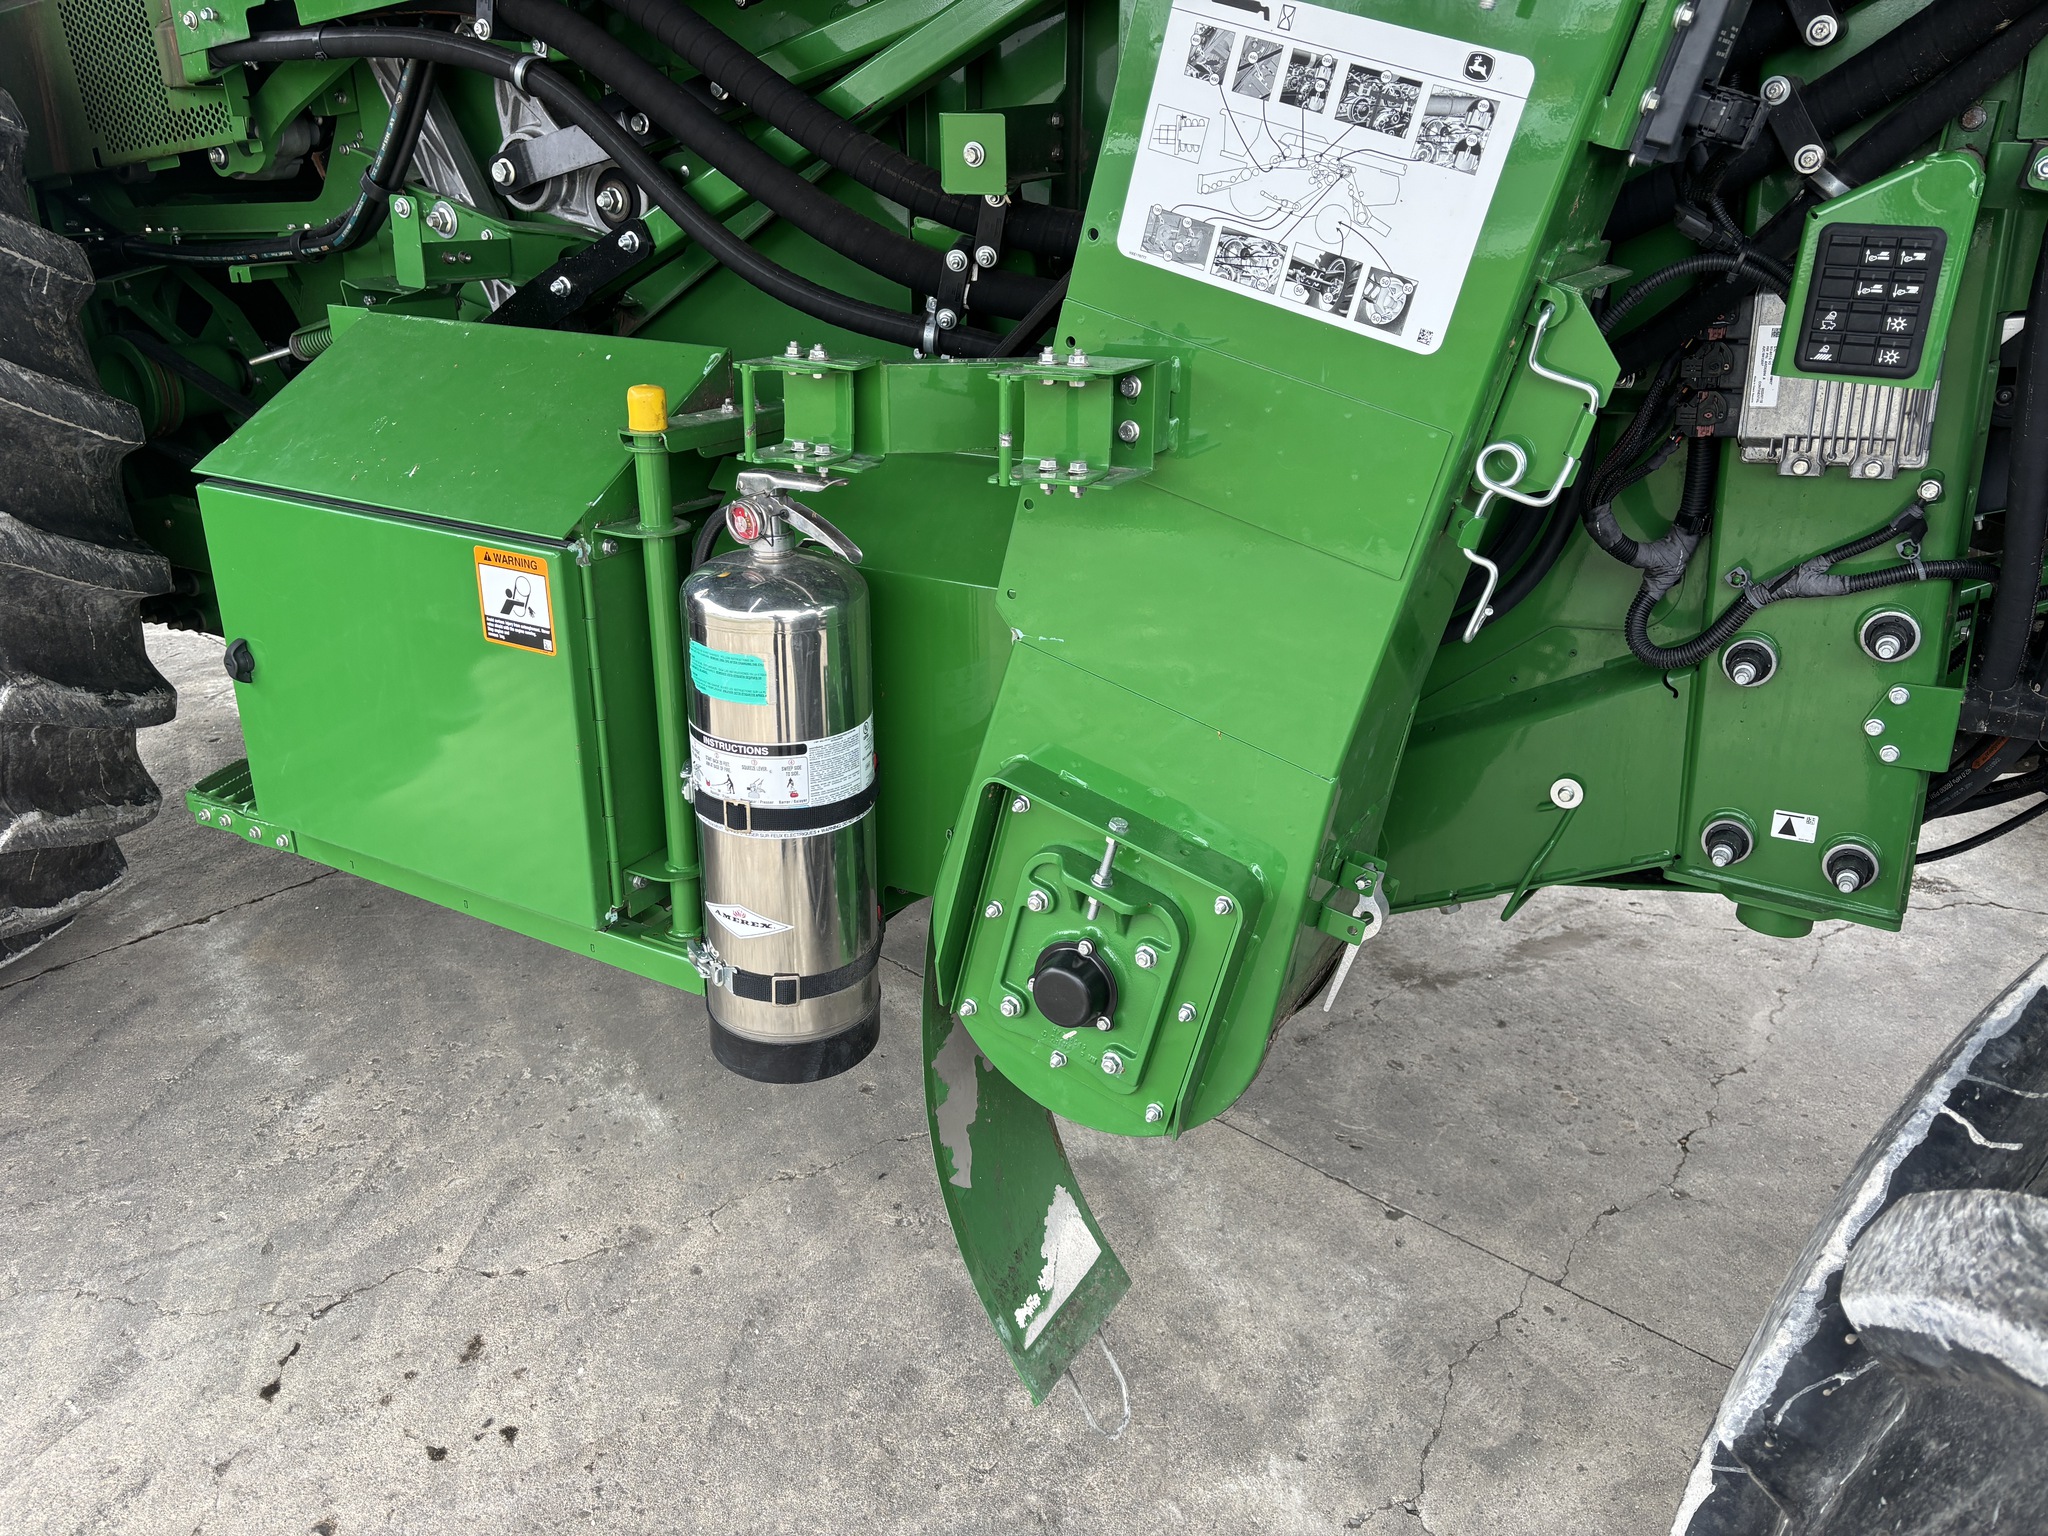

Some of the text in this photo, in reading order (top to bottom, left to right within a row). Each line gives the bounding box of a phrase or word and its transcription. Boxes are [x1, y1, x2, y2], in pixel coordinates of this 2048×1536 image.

[493, 552, 538, 570] WARNING
[702, 735, 769, 756] INSTRUCTIONS
[715, 909, 773, 929] AMEREX
